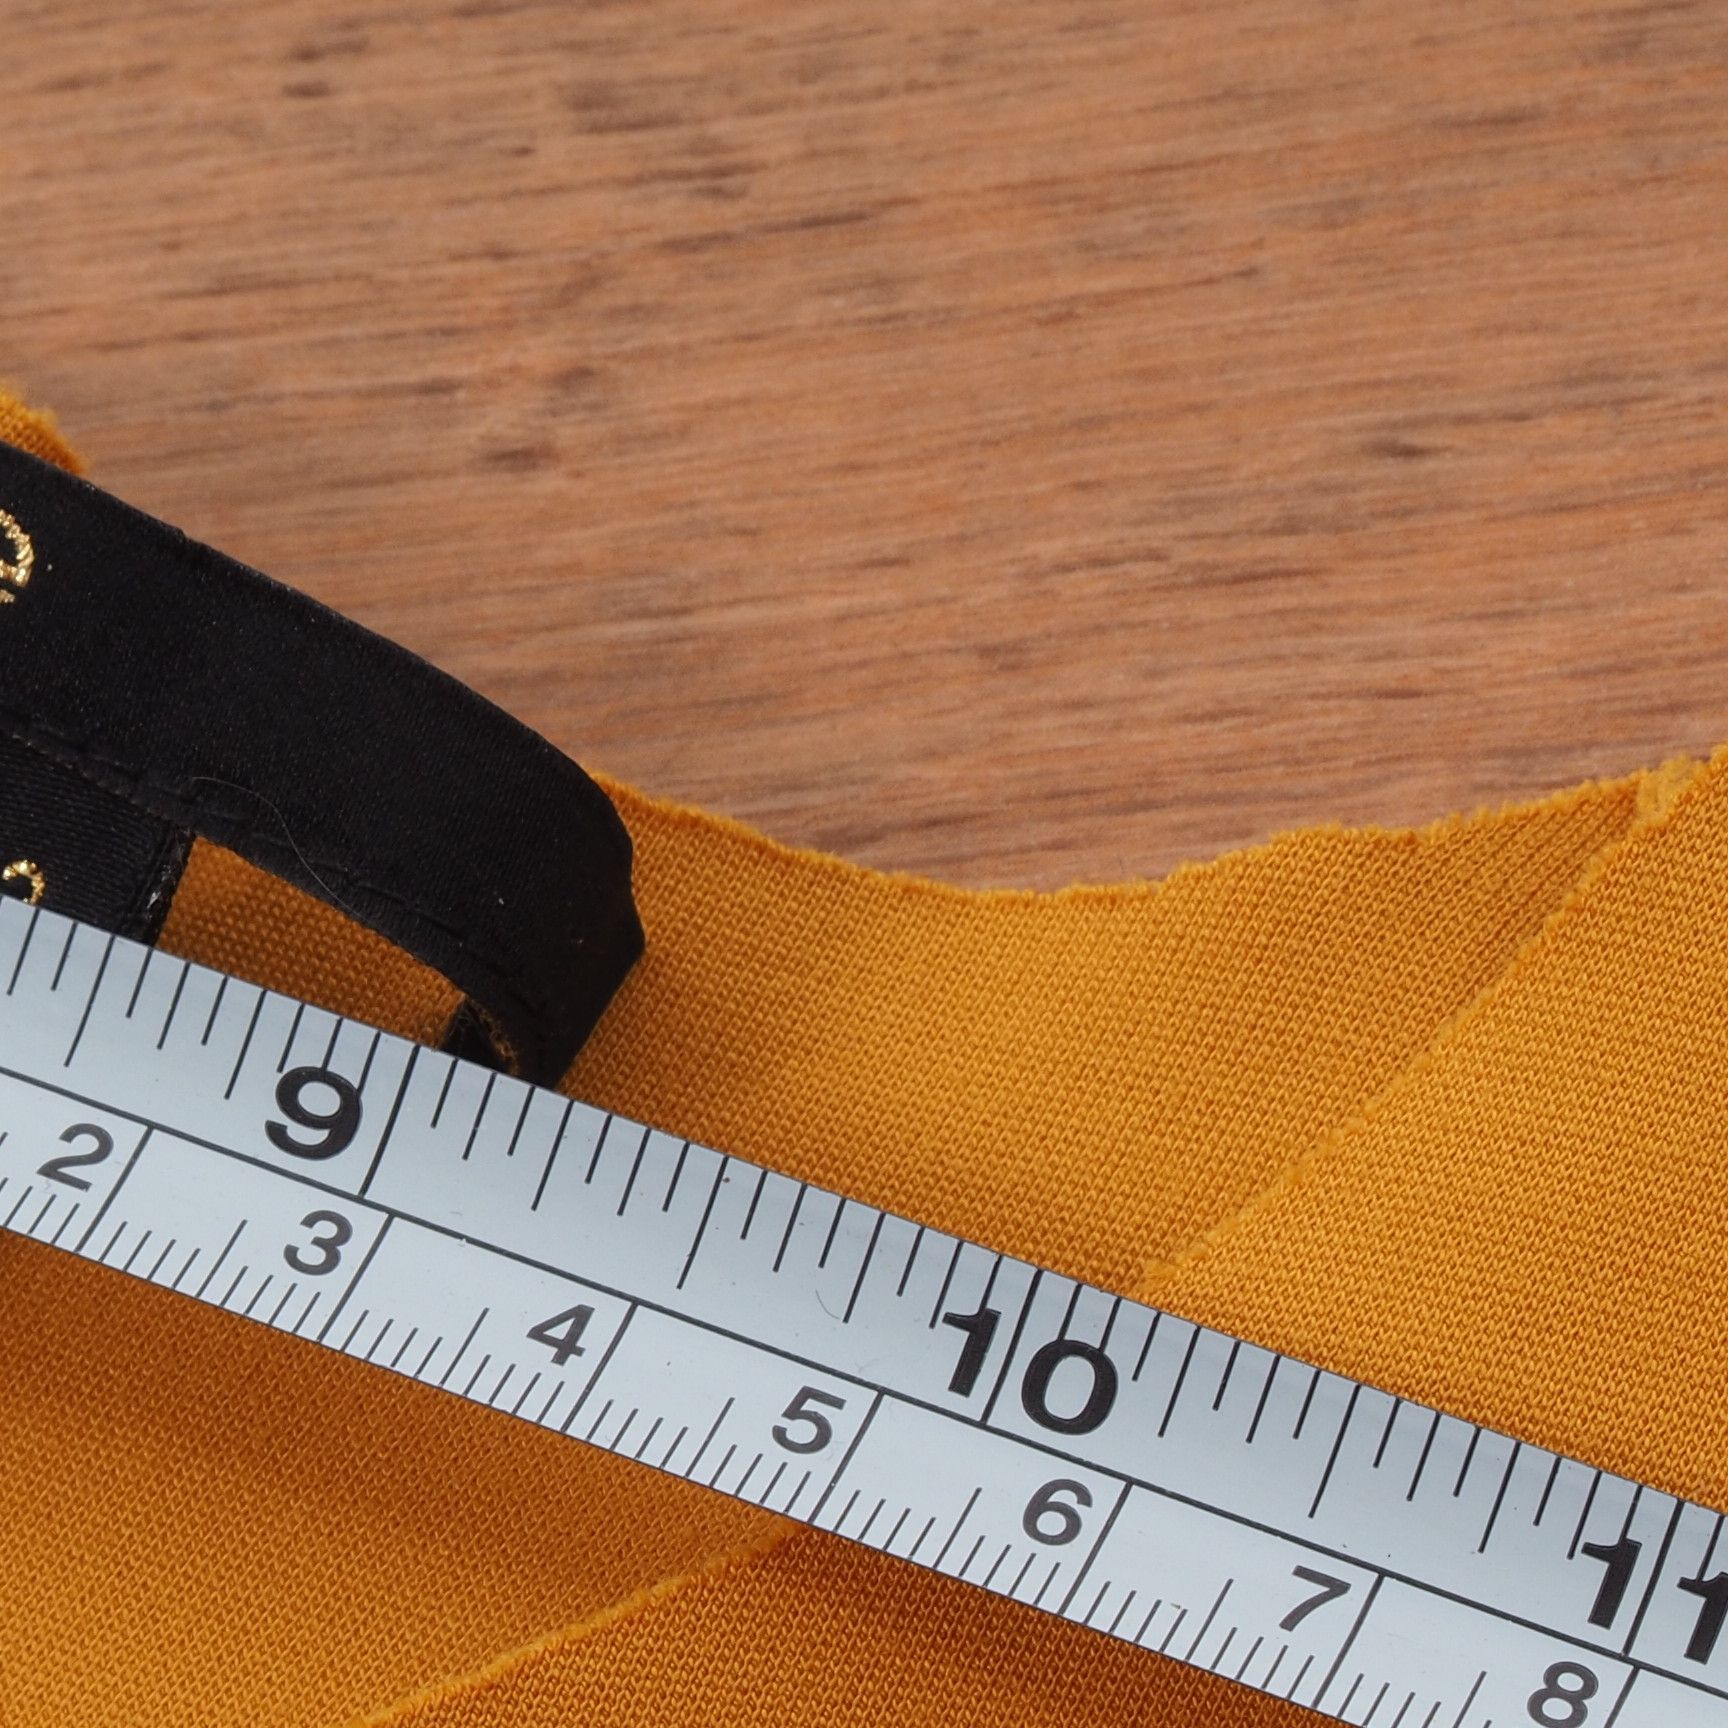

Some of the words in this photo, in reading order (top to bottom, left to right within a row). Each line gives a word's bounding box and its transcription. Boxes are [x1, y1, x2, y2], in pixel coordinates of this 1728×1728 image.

[265, 1066, 363, 1160] 9
[36, 1122, 115, 1192] 2
[283, 1210, 353, 1277] 3
[526, 1304, 595, 1367] 4
[941, 1307, 1118, 1436] 10
[772, 1385, 846, 1455] 5
[1022, 1479, 1093, 1546] 6
[1279, 1565, 1351, 1632] 7
